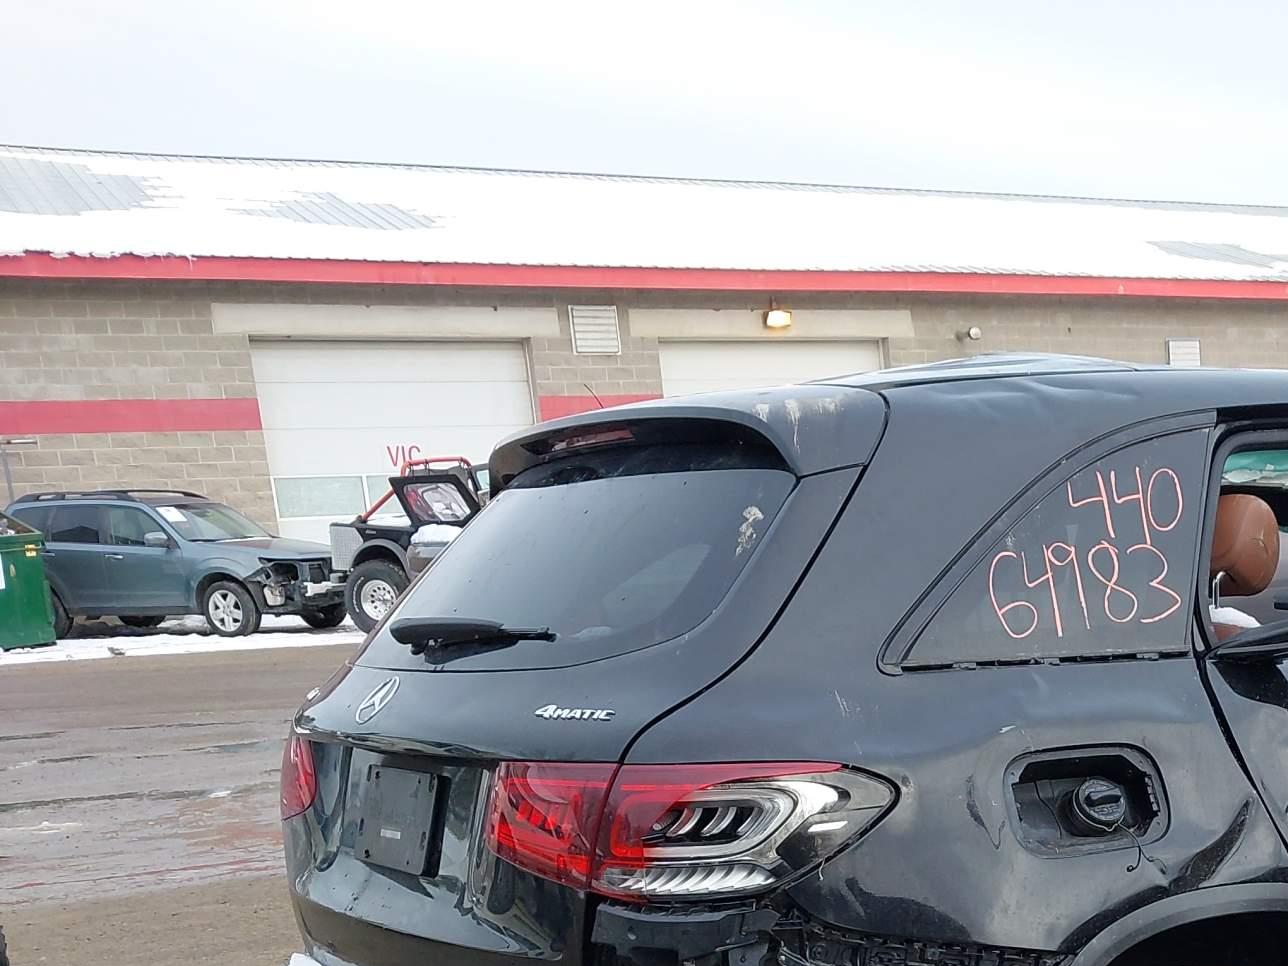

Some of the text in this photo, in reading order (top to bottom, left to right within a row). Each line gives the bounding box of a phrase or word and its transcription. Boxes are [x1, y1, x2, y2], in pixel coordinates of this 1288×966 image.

[1066, 466, 1184, 545] 440
[988, 540, 1182, 639] 64983
[534, 704, 616, 721] 4MATIC
